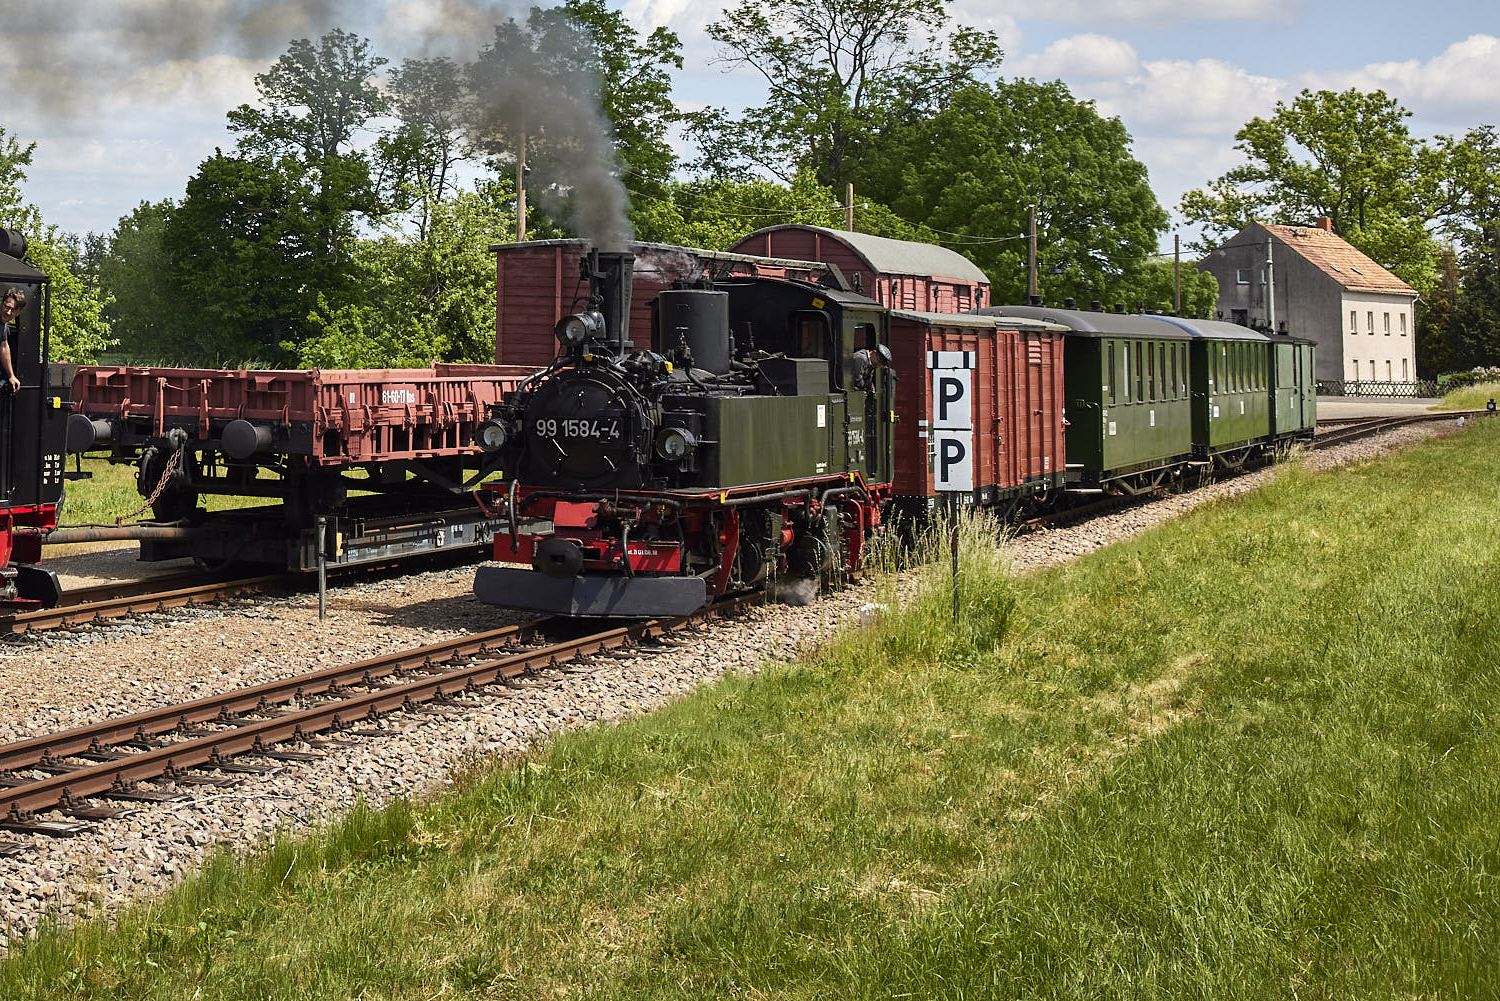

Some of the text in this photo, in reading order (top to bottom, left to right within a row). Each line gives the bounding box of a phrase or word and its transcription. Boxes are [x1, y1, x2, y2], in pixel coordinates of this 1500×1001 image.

[939, 377, 964, 420] P
[536, 419, 620, 439] 99 1584-4
[940, 438, 966, 483] P
